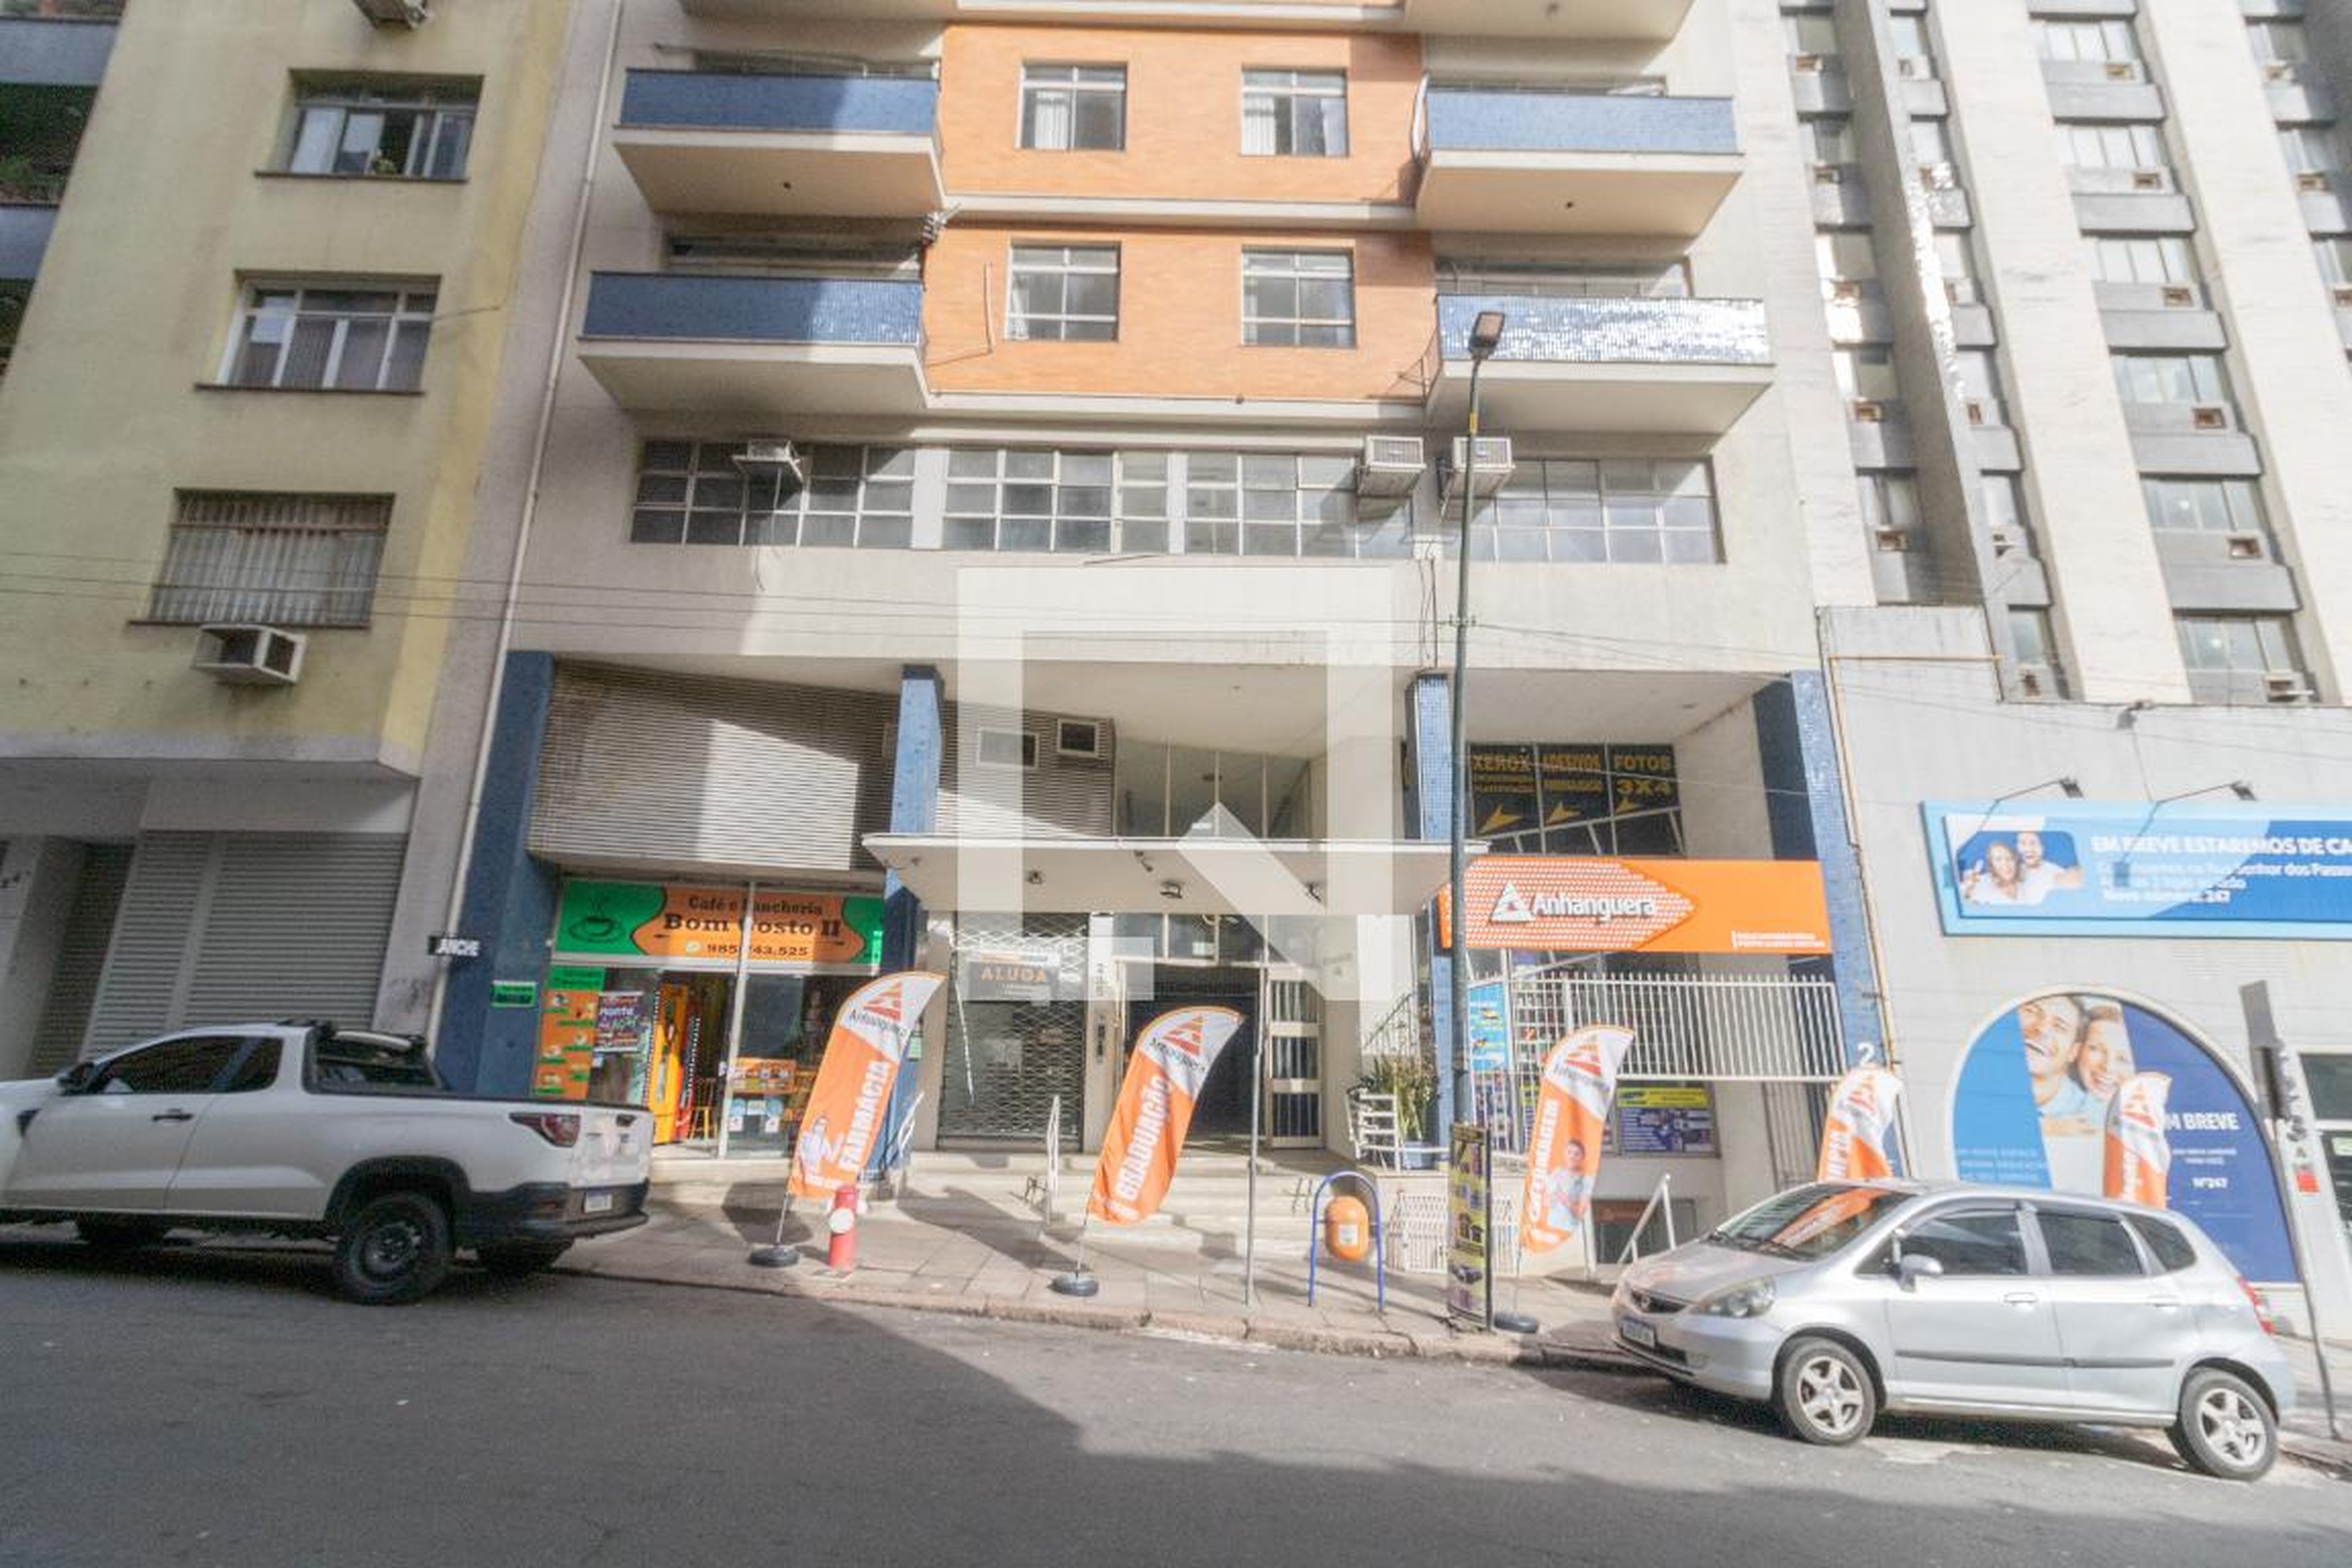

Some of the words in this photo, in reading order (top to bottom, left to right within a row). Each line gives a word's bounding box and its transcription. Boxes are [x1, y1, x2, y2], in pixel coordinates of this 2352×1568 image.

[1470, 754, 1530, 771] XEROX
[1613, 754, 1672, 771] FOTOS
[1616, 779, 1672, 795] 3X4
[2297, 837, 2325, 854] DE
[1534, 892, 1655, 924] Anhanguera
[663, 913, 730, 932] Bom
[737, 918, 815, 936] osto
[821, 920, 842, 937] II
[838, 1060, 889, 1172] FARMÁCIA
[2182, 1112, 2239, 1131] BREVE
[1114, 1073, 1170, 1202] GRADUAÇÃO
